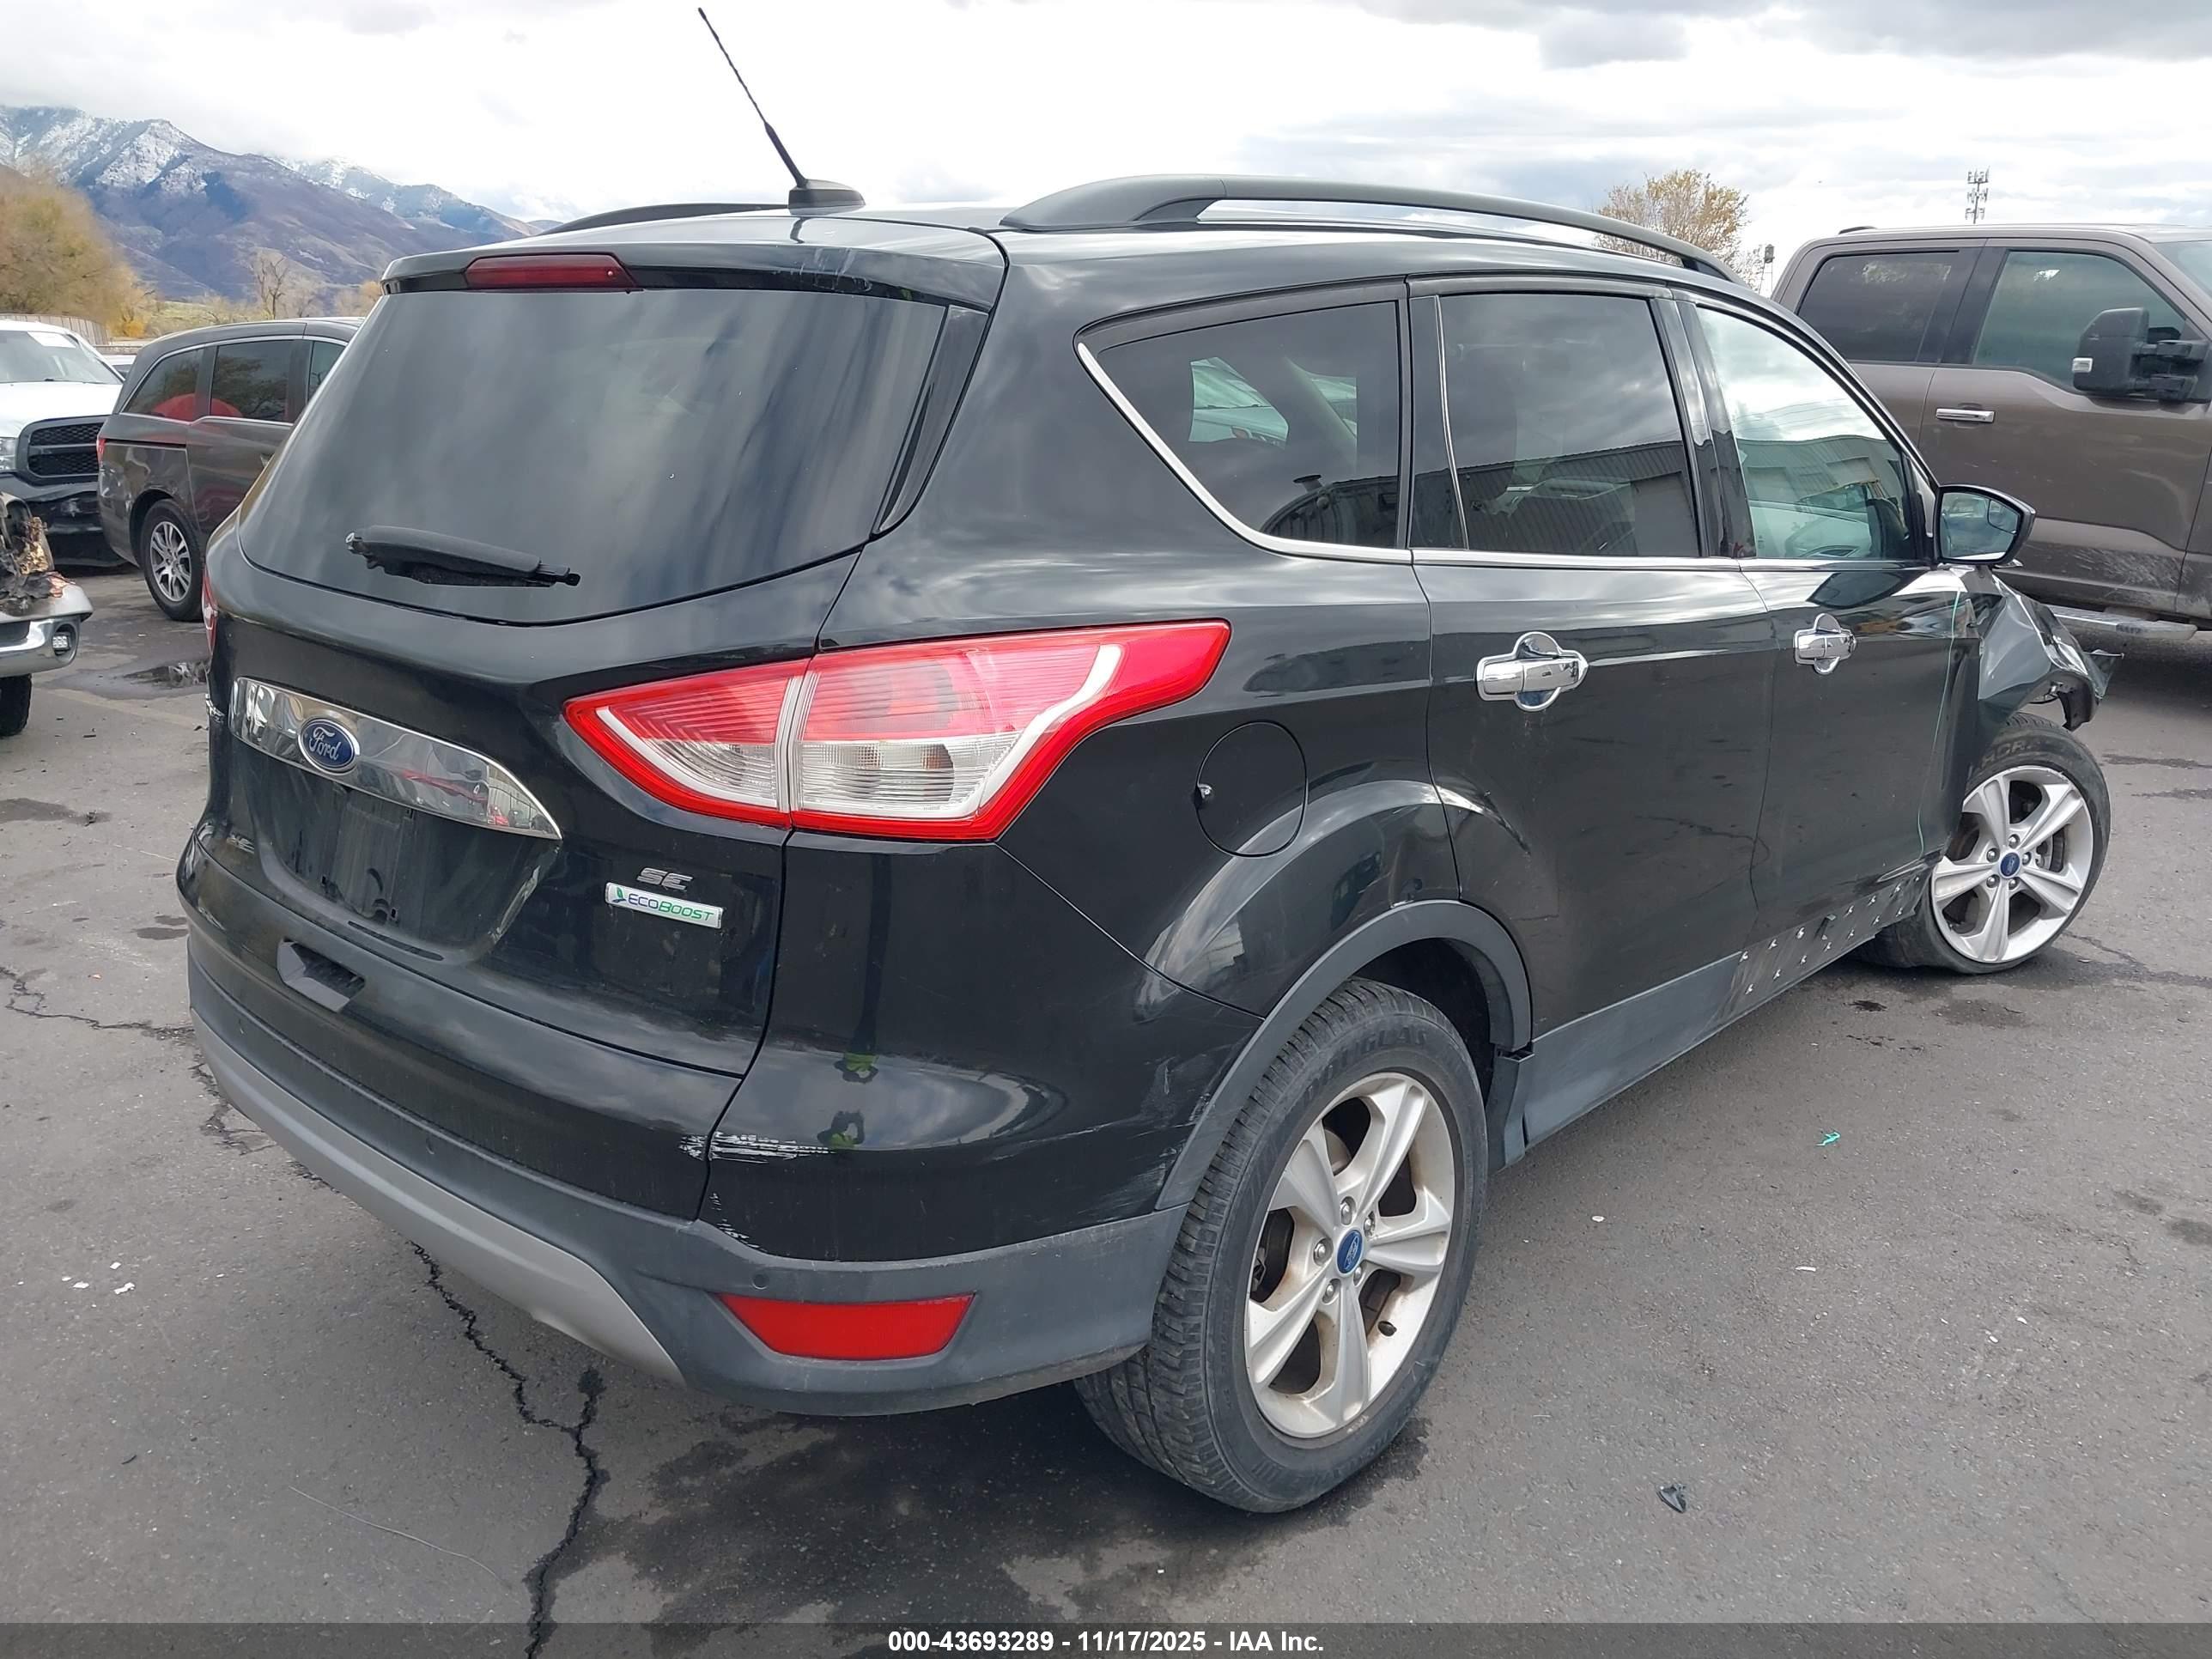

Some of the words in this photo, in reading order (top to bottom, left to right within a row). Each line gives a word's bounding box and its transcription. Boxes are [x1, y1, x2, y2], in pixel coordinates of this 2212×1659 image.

[308, 726, 341, 761] Ford
[636, 867, 693, 890] SE
[628, 893, 714, 921] ECOBOOST
